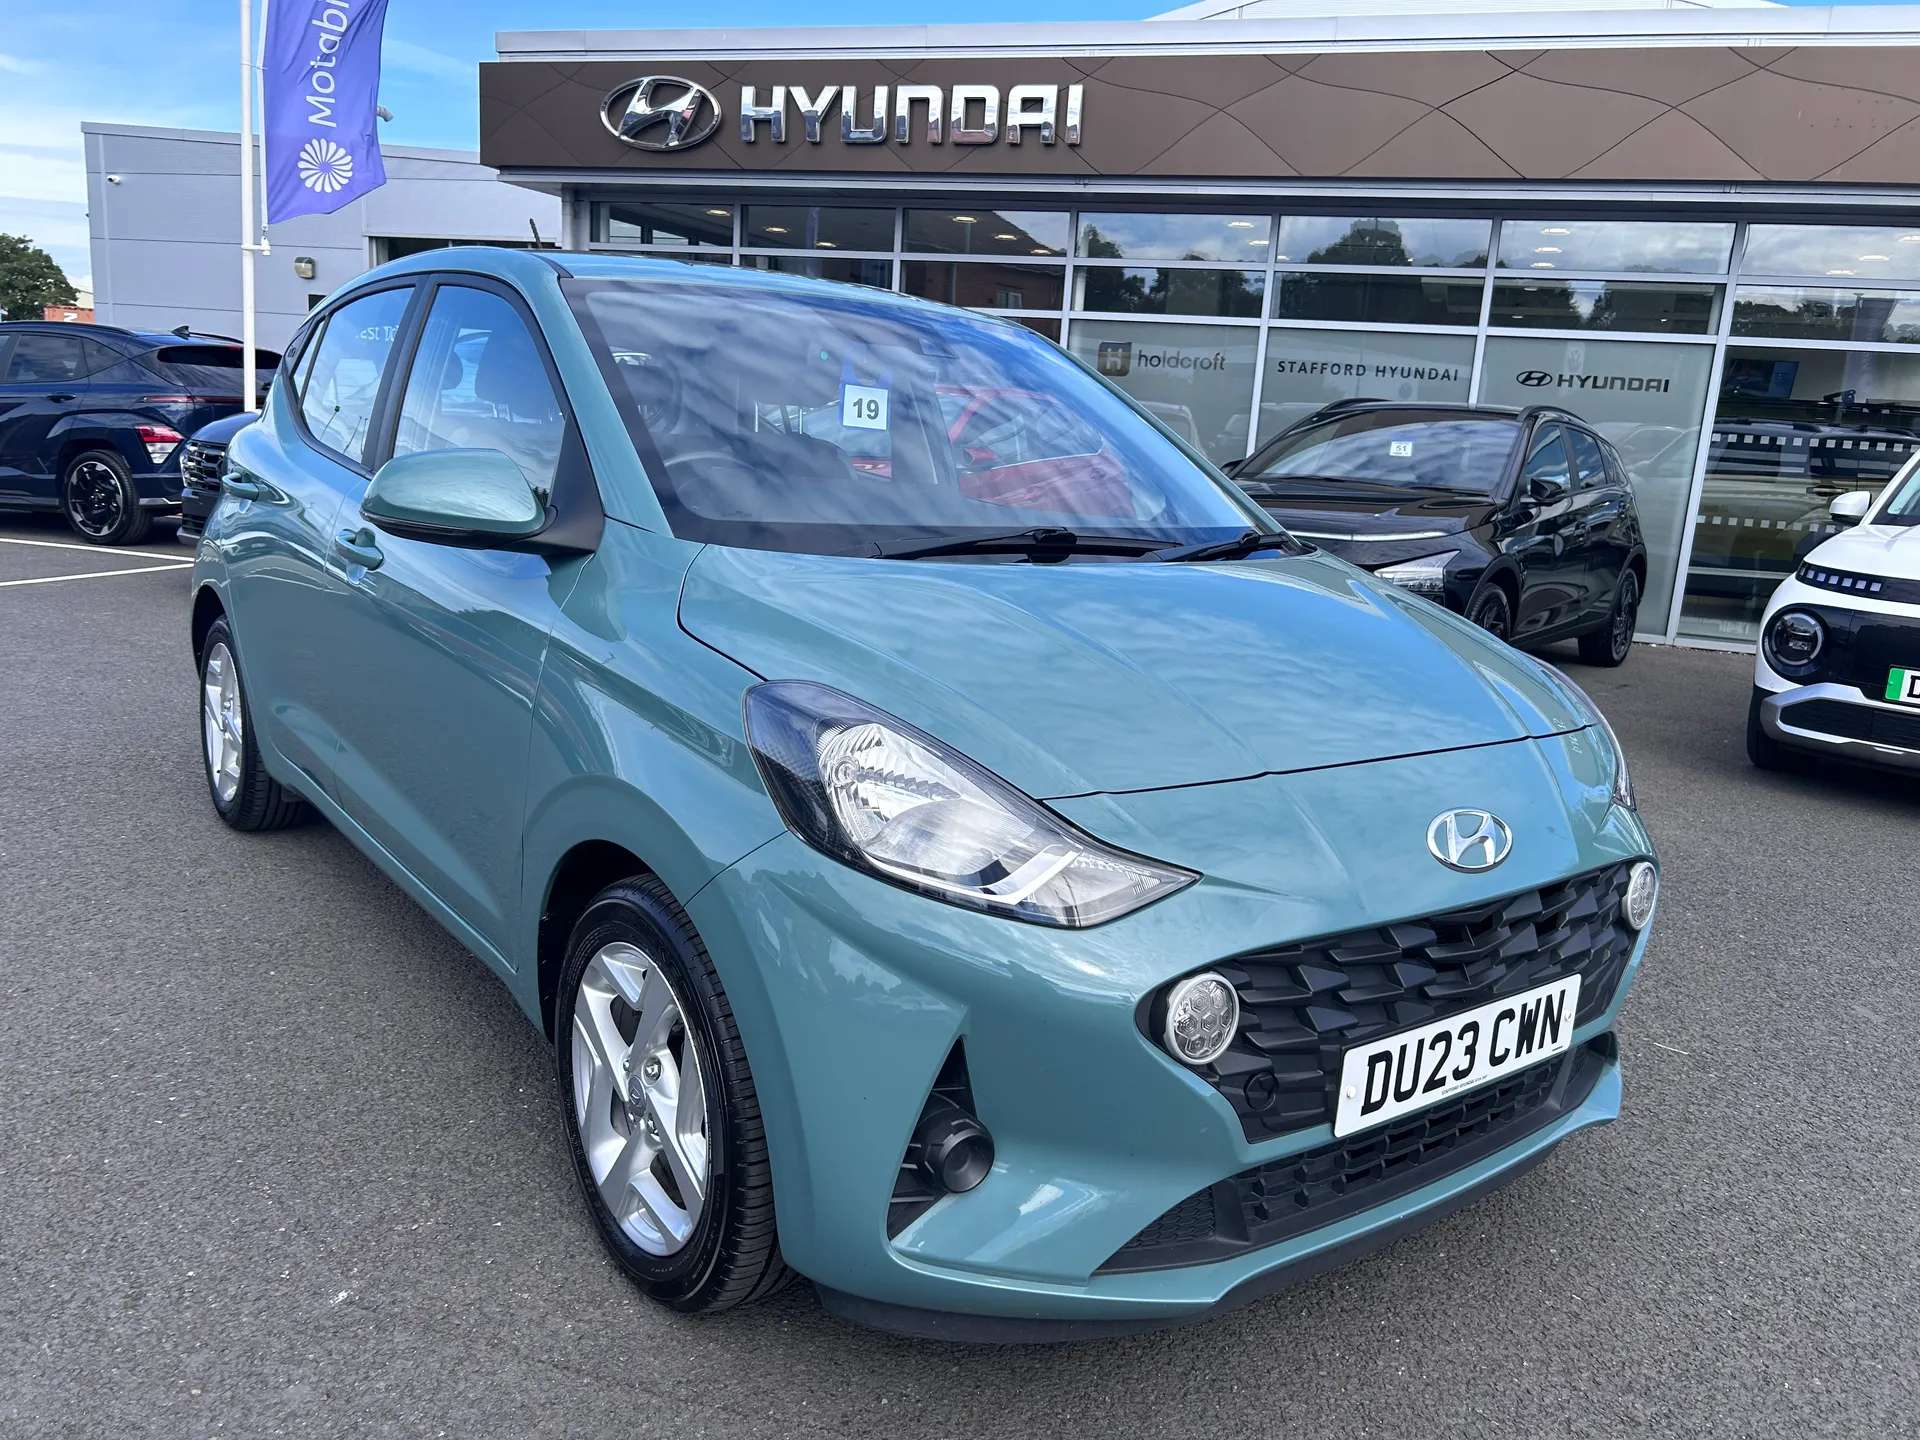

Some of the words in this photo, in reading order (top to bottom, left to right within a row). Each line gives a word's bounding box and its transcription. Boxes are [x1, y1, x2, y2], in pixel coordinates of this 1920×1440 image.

[740, 84, 1084, 146] HYUNDAI
[1137, 350, 1226, 371] holdcroft
[1277, 359, 1366, 377] STAFFORD
[1375, 364, 1459, 382] HYUNDAI
[1556, 373, 1670, 393] HYUNDAI
[852, 397, 880, 420] 19
[1360, 1020, 1481, 1117] DU23
[1488, 989, 1566, 1068] CWN
